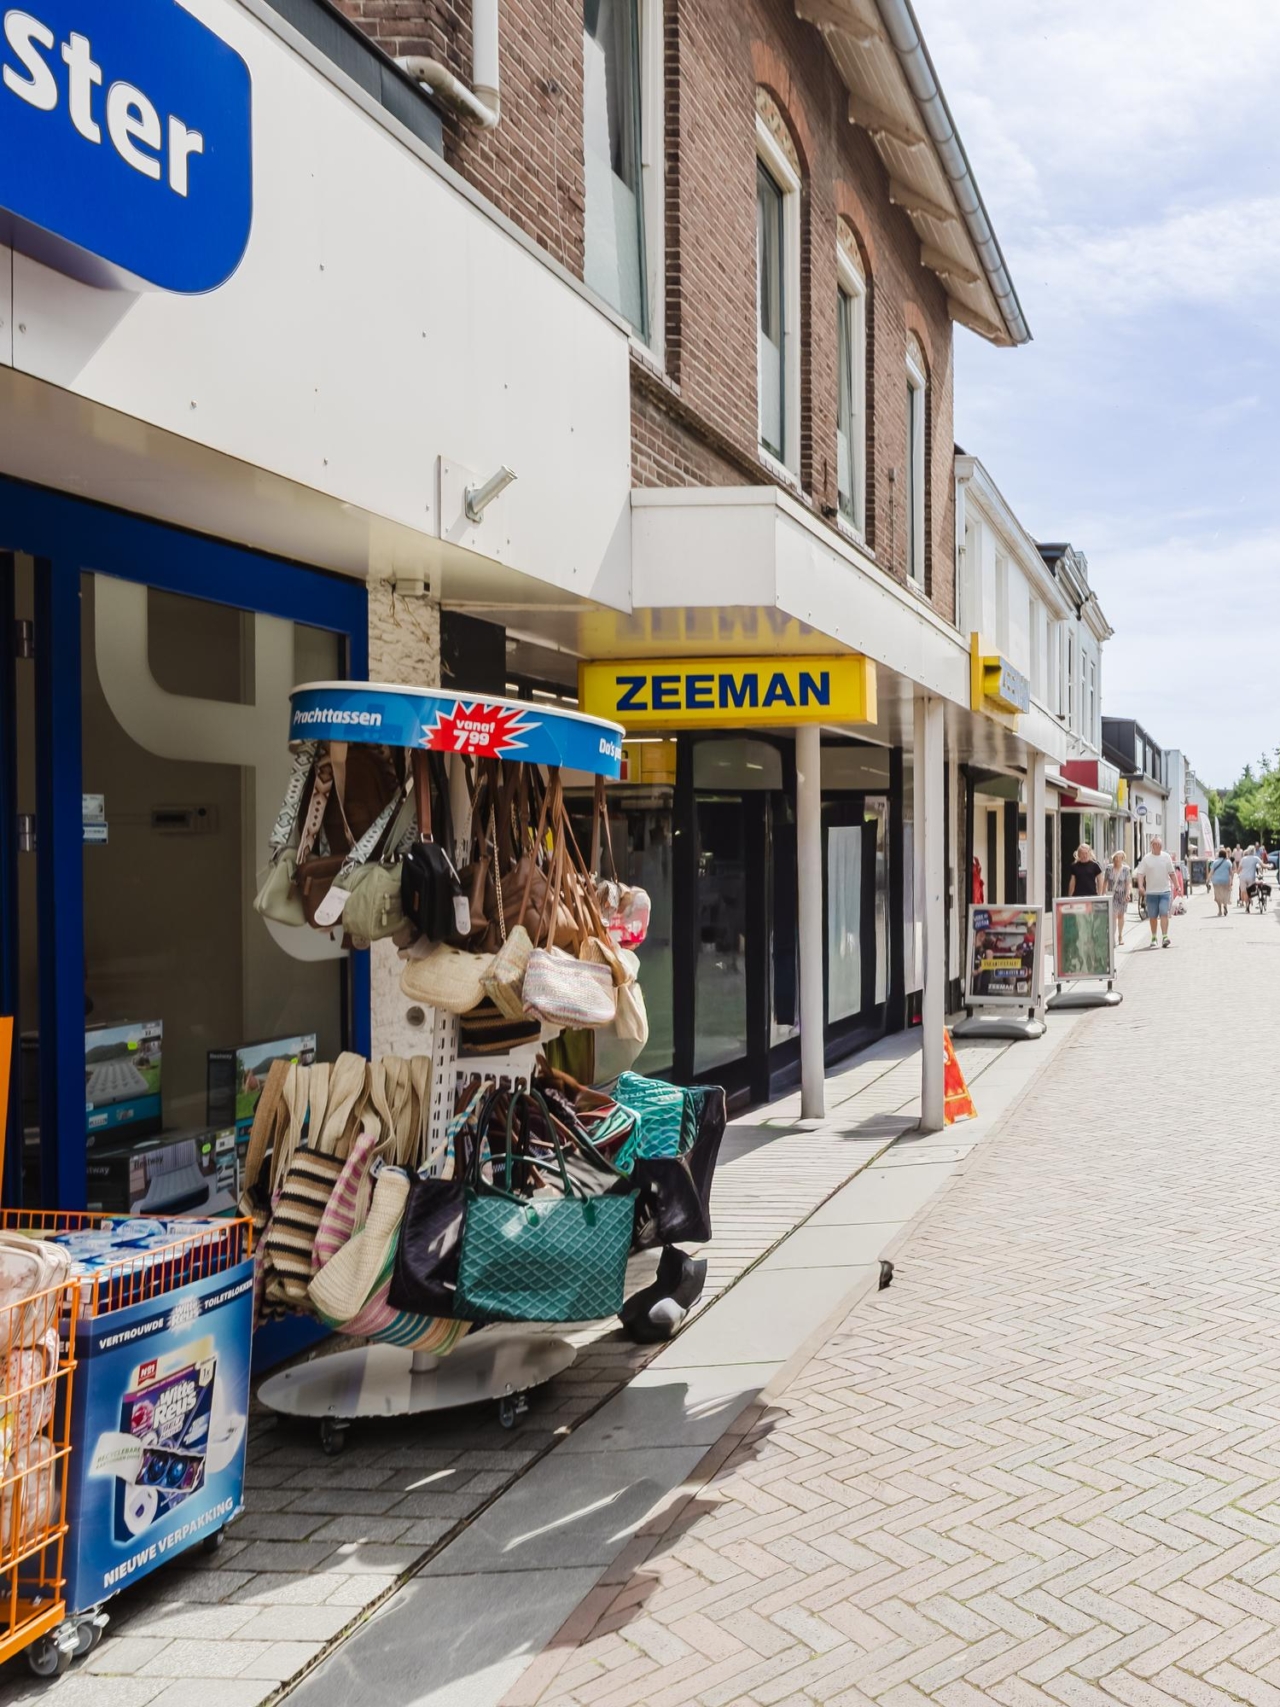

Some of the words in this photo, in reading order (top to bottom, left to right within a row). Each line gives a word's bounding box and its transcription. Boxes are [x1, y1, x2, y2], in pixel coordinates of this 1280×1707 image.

[615, 671, 831, 712] ZEEMAN
[293, 707, 382, 727] Prachttassen
[456, 719, 496, 734] vanaf
[204, 1278, 253, 1309] TOILETBLOKKEN
[99, 1317, 164, 1349] VERTROUWDE
[160, 1380, 196, 1405] Witte
[153, 1391, 197, 1429] Reus
[103, 1549, 157, 1588] NIEUWE
[158, 1497, 233, 1555] VERPAKKING
